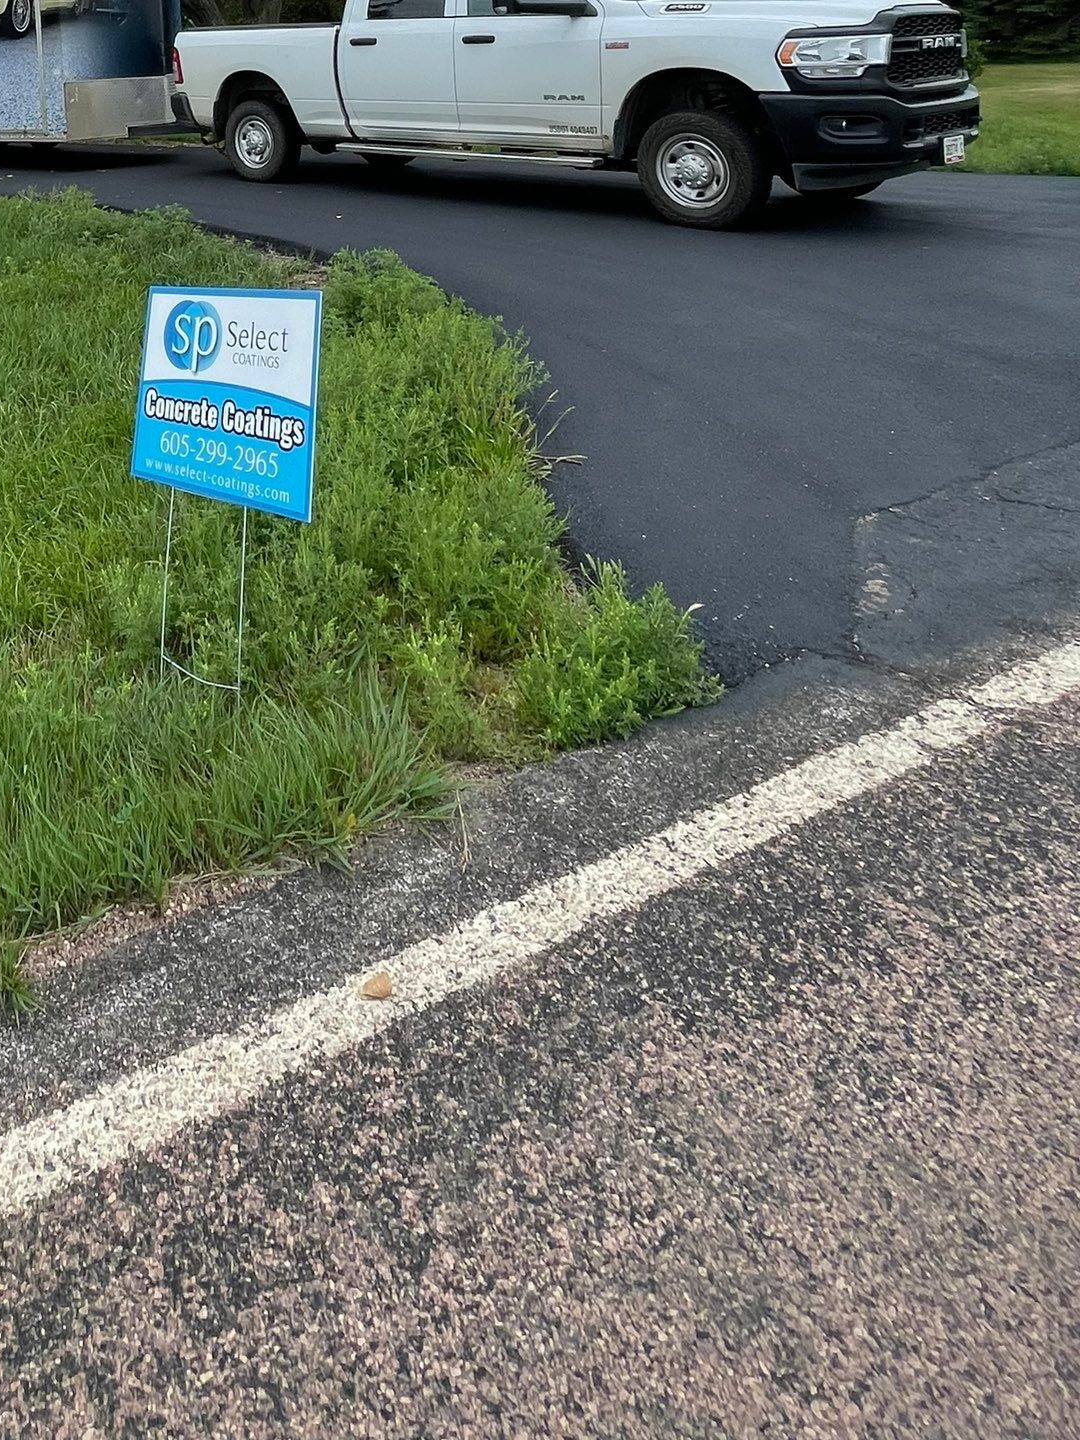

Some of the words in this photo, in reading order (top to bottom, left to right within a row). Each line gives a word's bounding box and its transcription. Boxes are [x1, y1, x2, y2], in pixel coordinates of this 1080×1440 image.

[921, 36, 955, 50] RAM
[226, 321, 289, 353] Select
[232, 352, 280, 369] COATINGS
[145, 387, 218, 430] Concrete
[221, 399, 305, 452] Coatings
[160, 430, 279, 478] 605-299-2965
[145, 458, 290, 503] www.select-coatings.com
